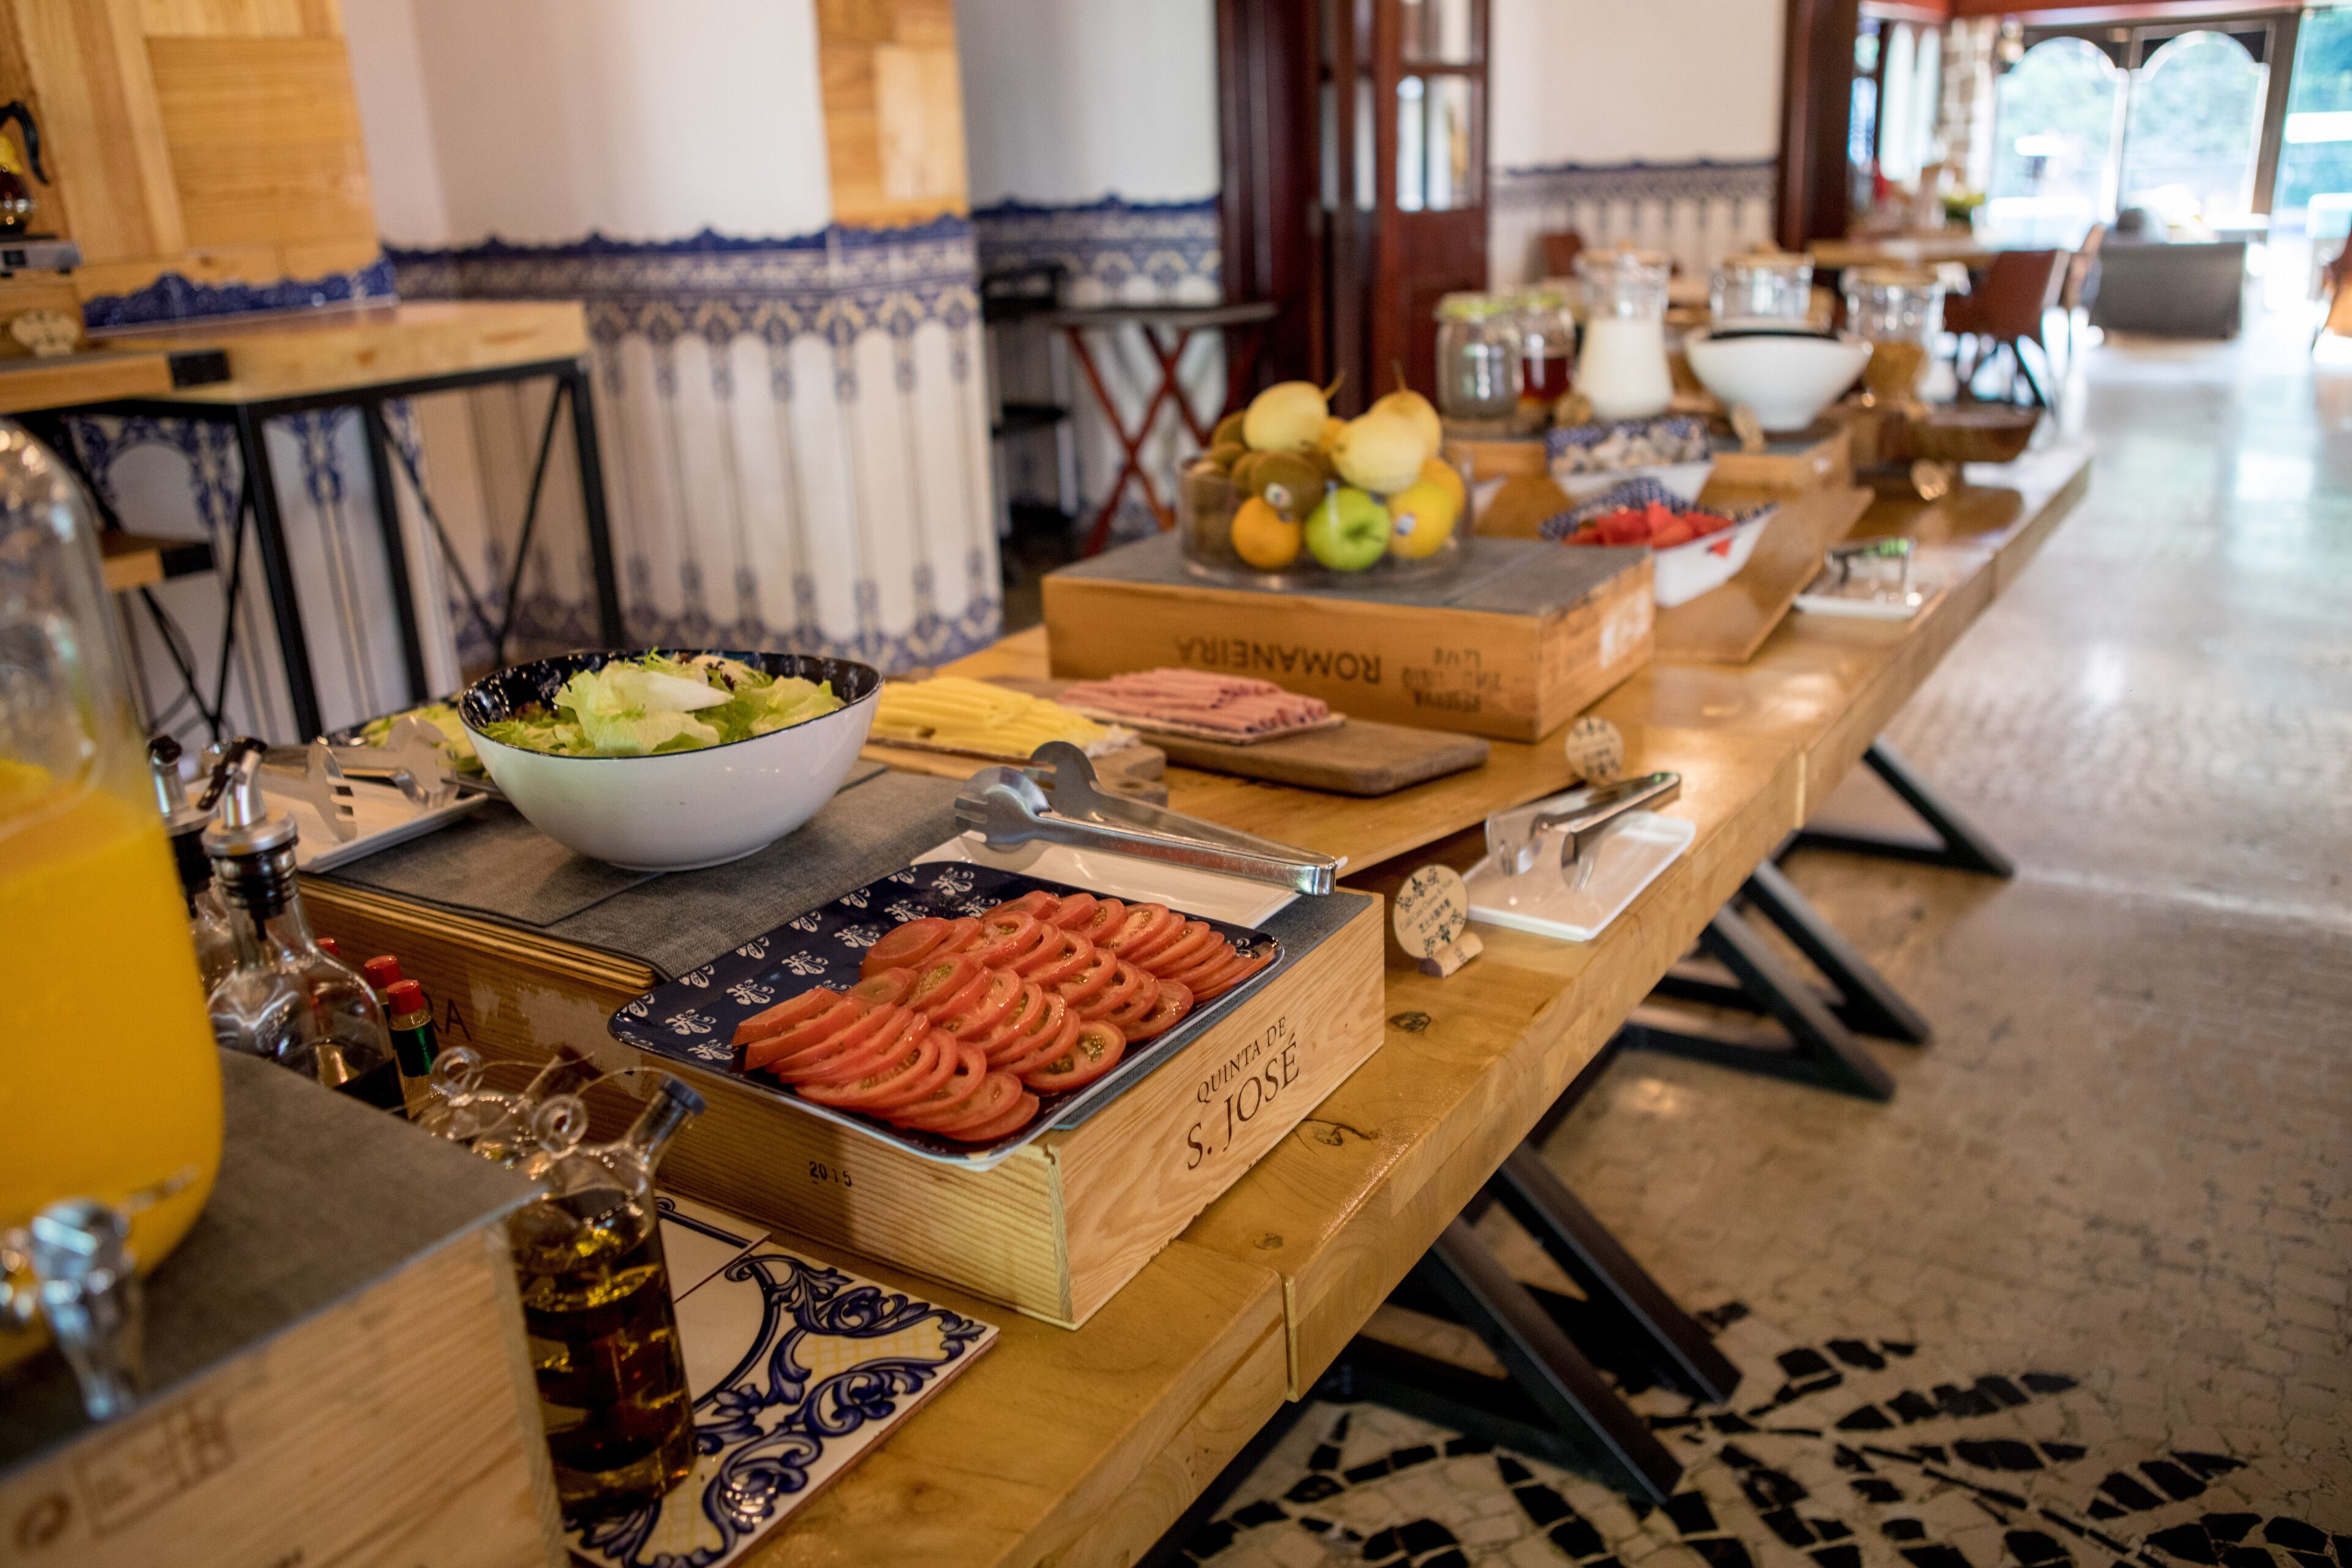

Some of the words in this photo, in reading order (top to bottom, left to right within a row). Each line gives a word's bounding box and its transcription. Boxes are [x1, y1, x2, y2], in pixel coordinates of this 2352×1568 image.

[1175, 638, 1381, 684] ROMANEIRA
[1197, 1038, 1261, 1104] QUINTA
[1266, 1016, 1286, 1047] DE
[1187, 1121, 1212, 1170] S.
[1223, 1032, 1299, 1153] JOSÉ
[809, 1161, 852, 1186] 2015
